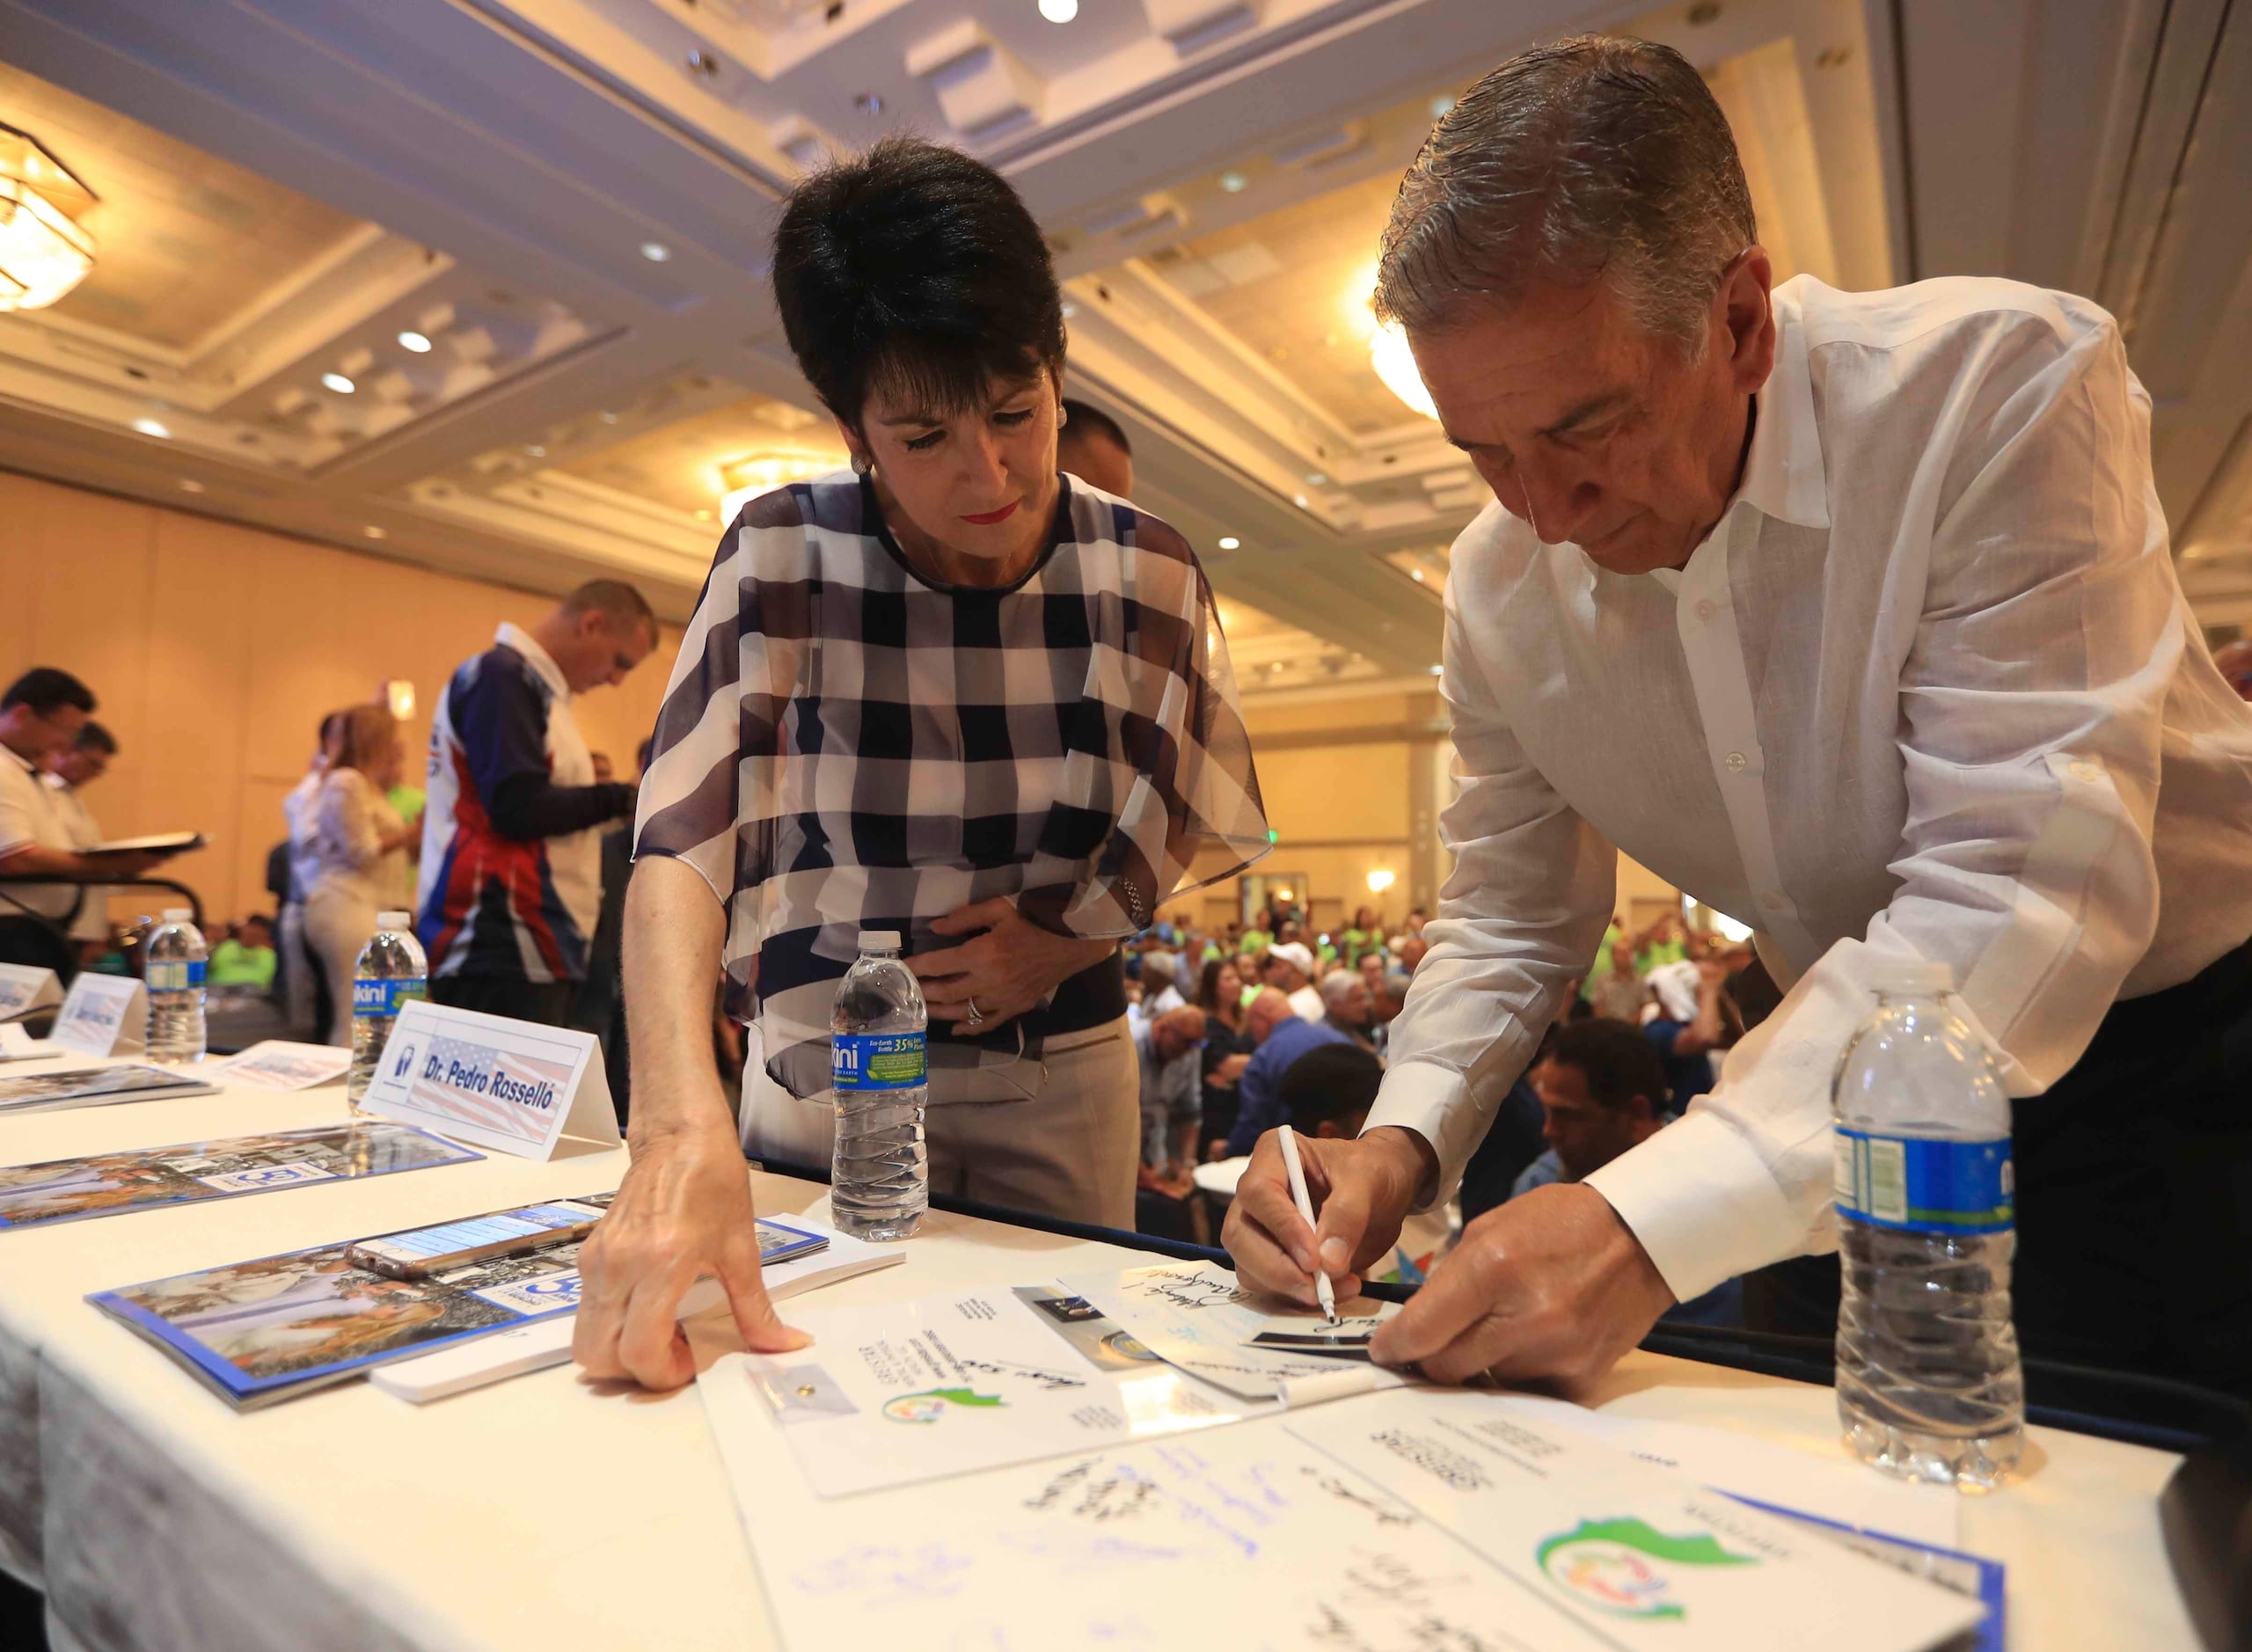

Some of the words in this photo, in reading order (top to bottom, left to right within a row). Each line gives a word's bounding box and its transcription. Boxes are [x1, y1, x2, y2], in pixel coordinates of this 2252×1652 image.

[424, 1055, 442, 1080] Dr.
[446, 1059, 489, 1093] Pedro
[490, 1071, 554, 1109] Rosselló
